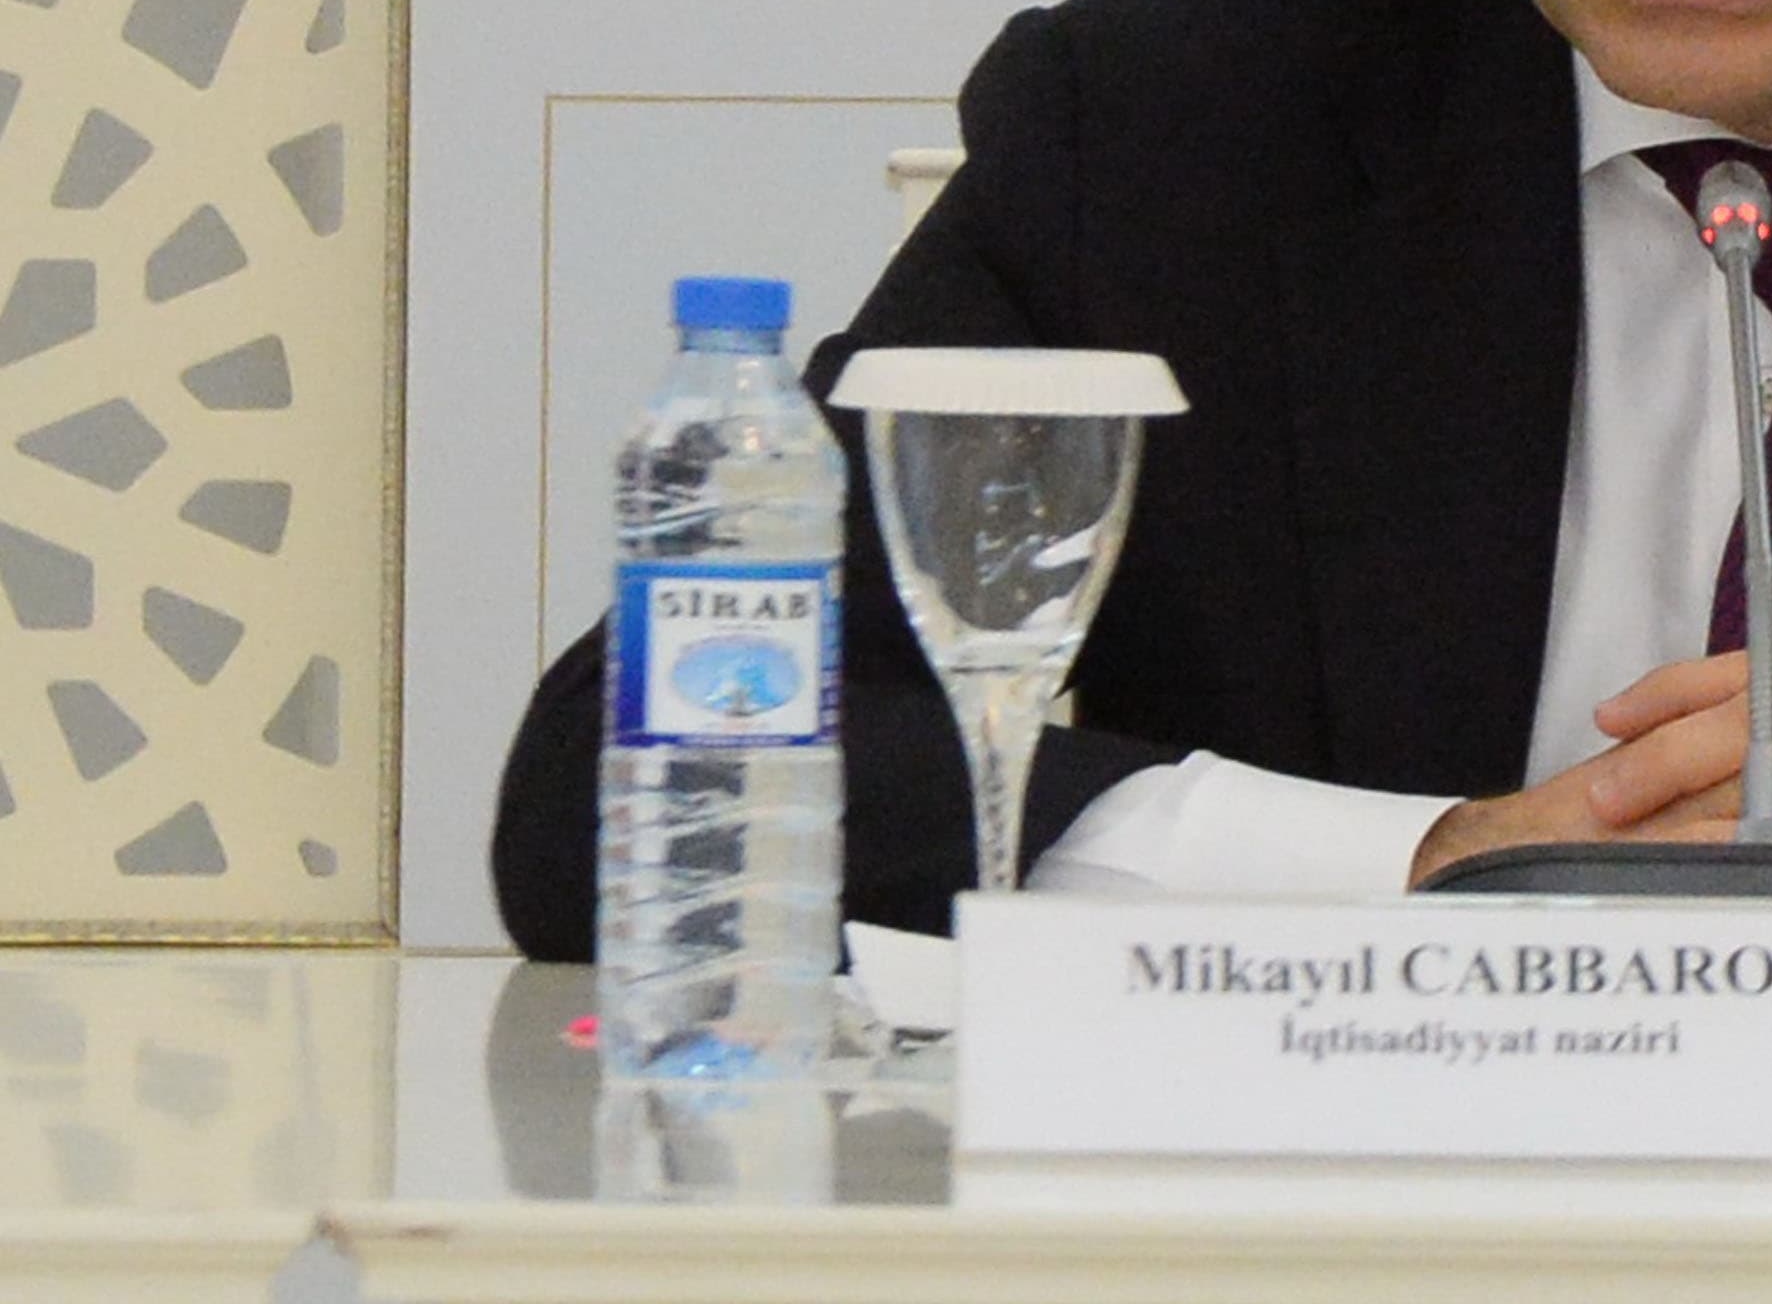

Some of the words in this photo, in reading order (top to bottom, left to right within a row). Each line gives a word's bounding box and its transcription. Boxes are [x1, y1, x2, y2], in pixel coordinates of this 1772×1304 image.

[1129, 943, 1375, 1008] Mikayıl
[1280, 1012, 1537, 1063] İqtisadiyyat
[1554, 1020, 1680, 1055] naziri
